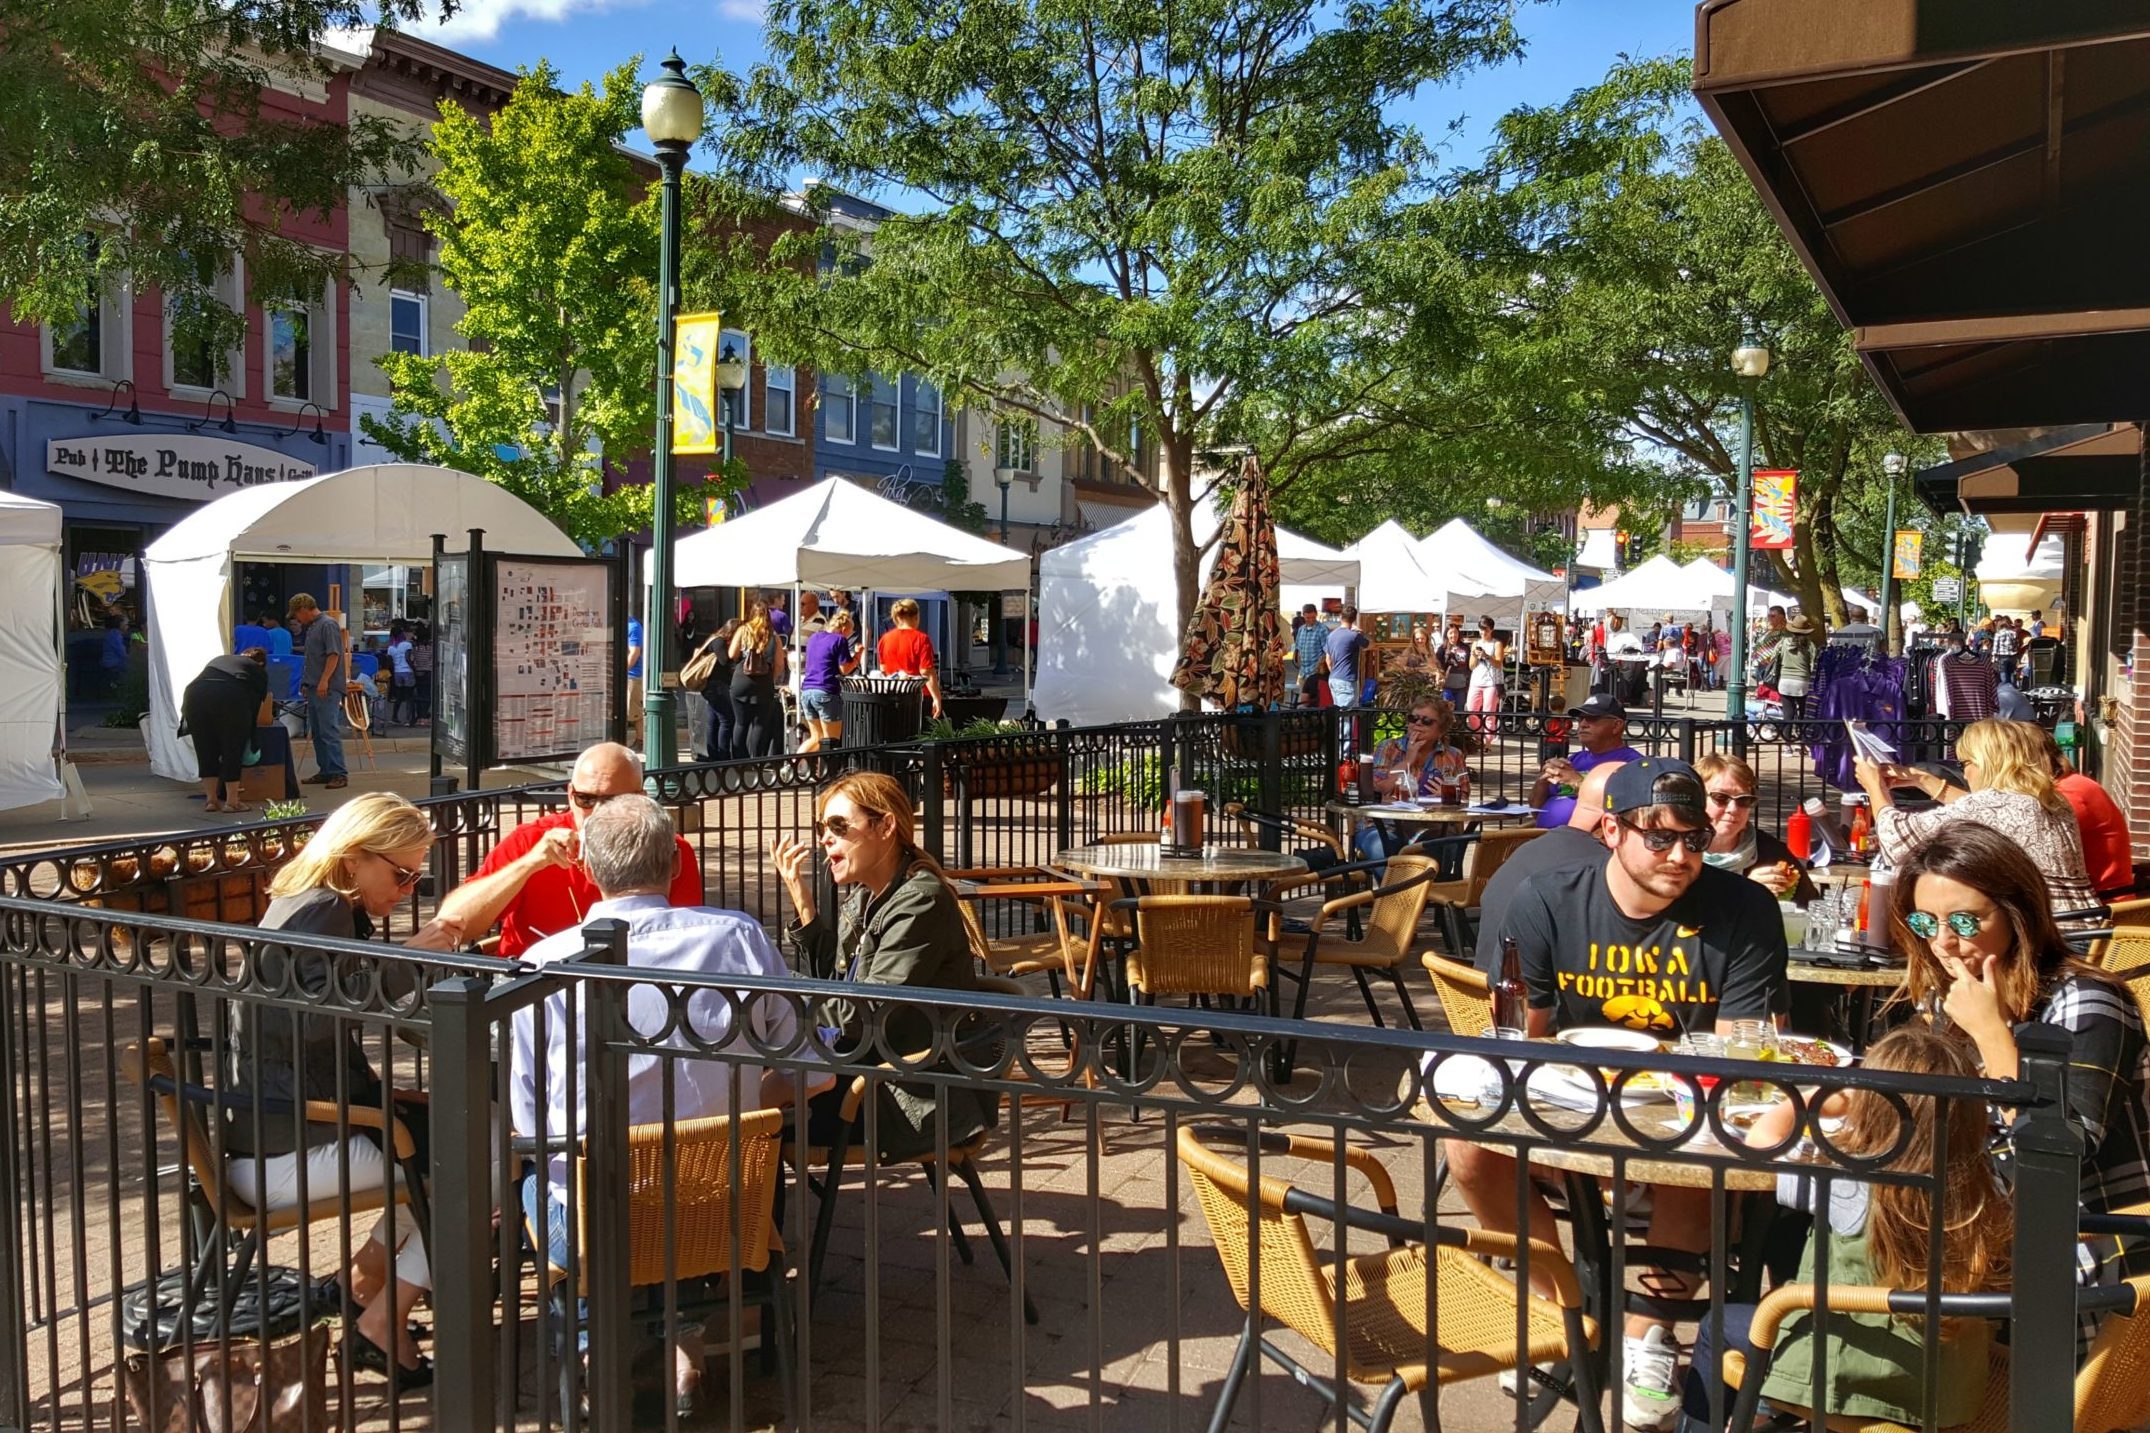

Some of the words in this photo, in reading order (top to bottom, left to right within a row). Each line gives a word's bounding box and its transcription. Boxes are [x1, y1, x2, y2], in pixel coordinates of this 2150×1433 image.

[54, 447, 87, 466] Pub
[105, 448, 148, 479] The
[154, 449, 220, 489] Pump
[77, 552, 126, 577] UNI
[1589, 943, 1689, 976] IOWA
[1557, 971, 1718, 1004] FOOTBALL
